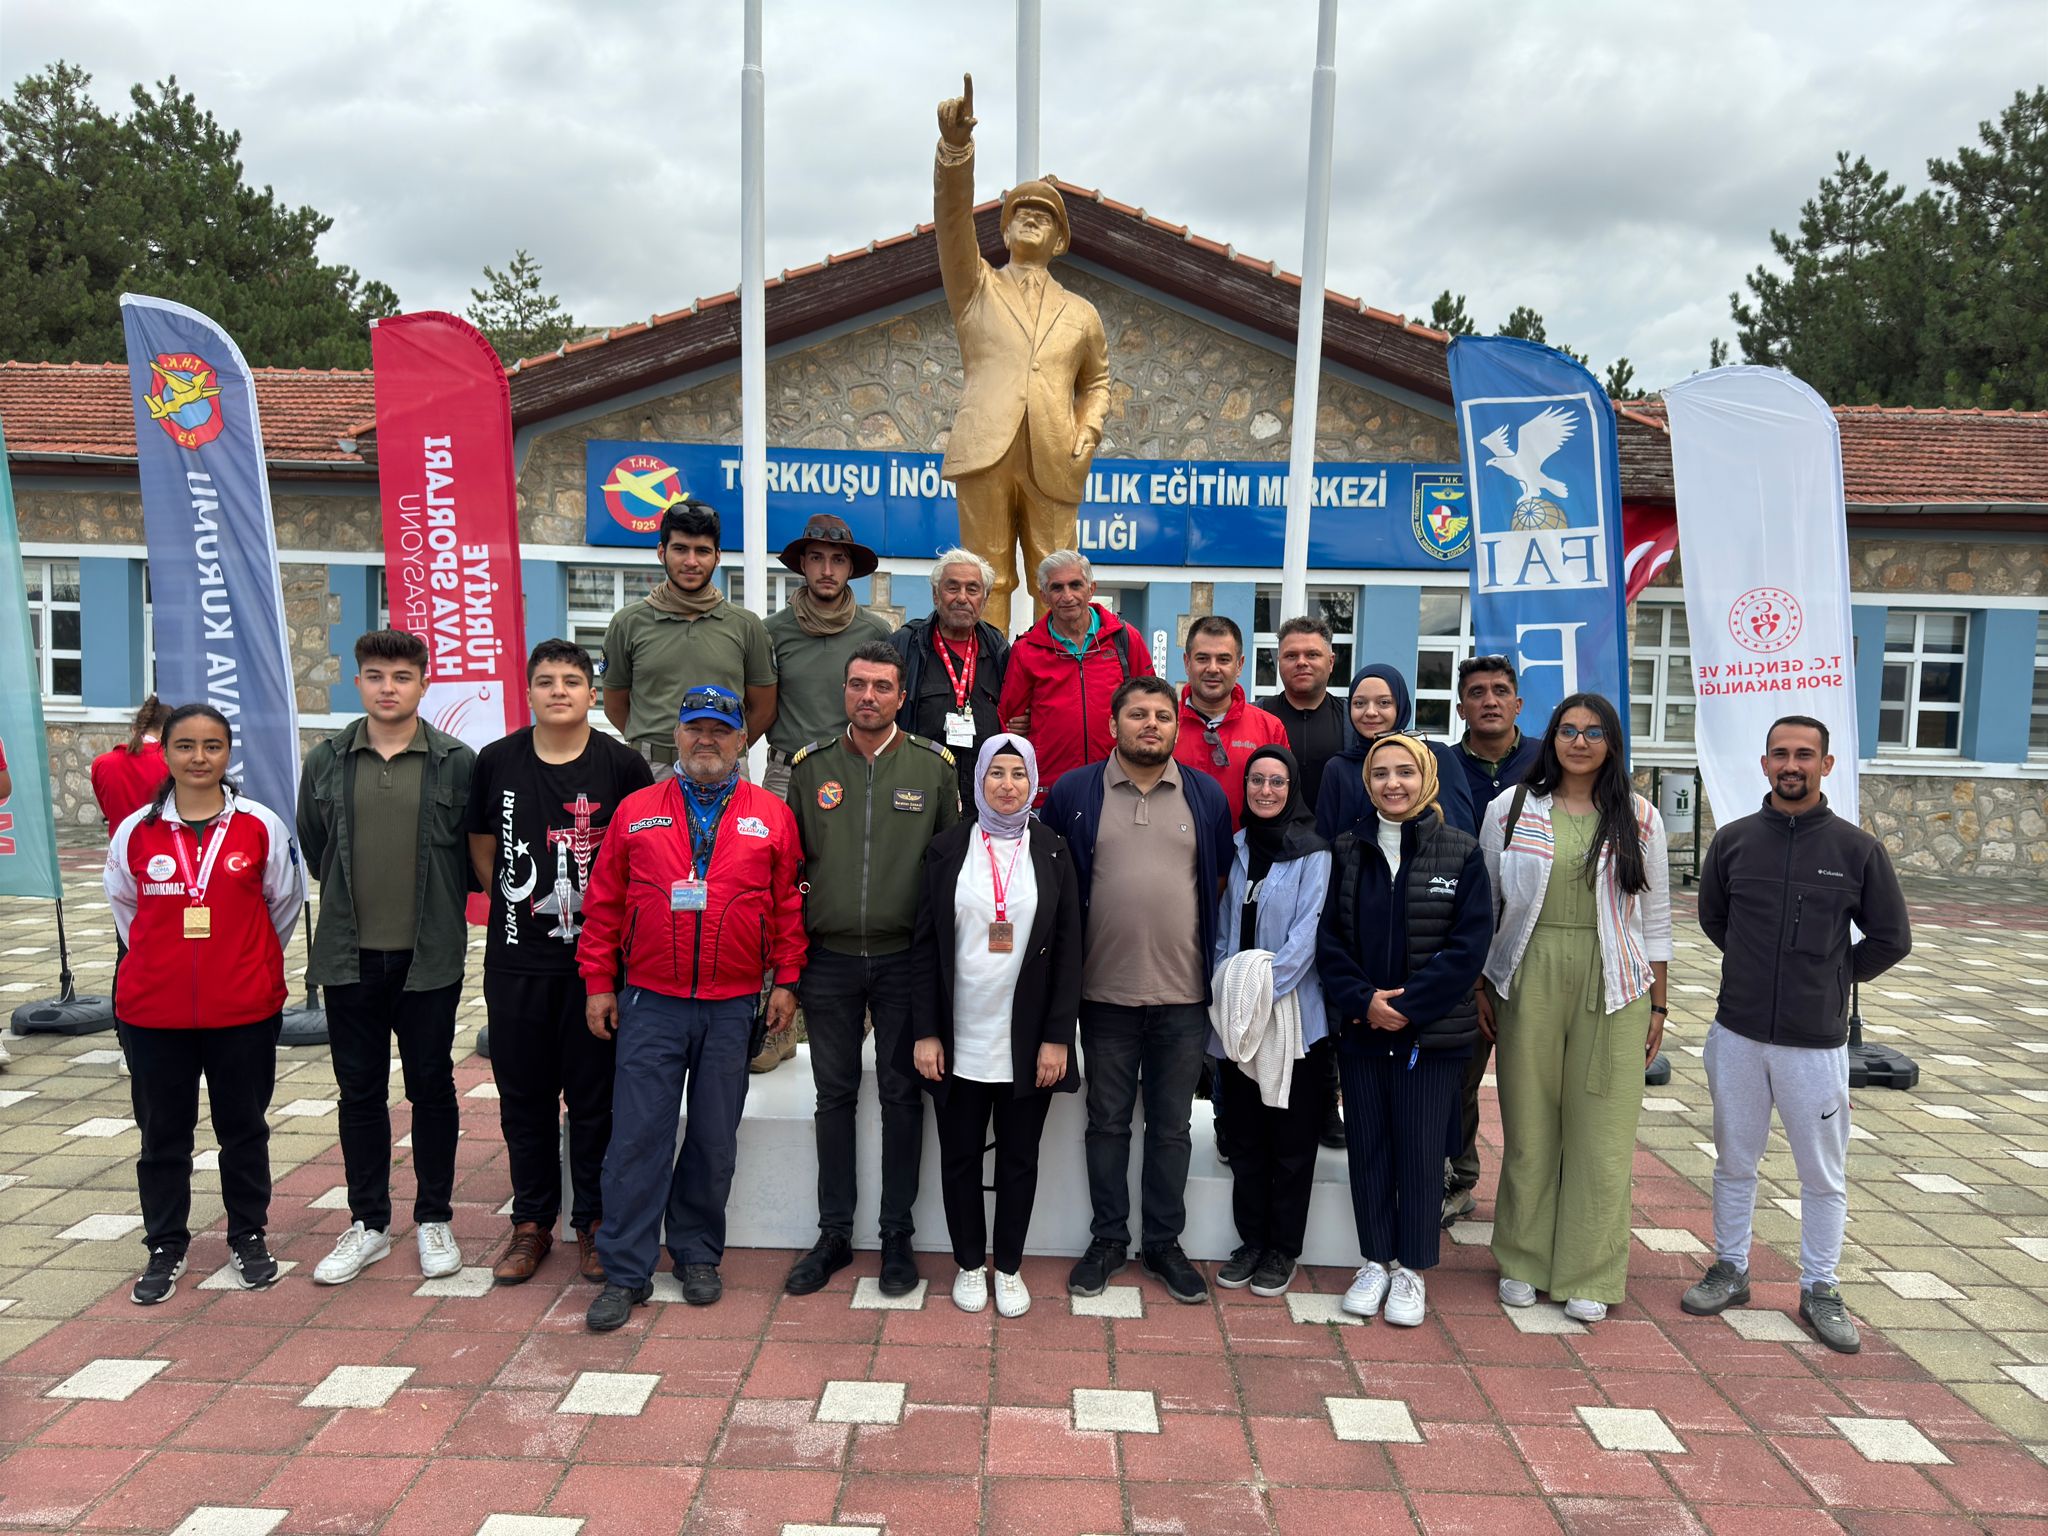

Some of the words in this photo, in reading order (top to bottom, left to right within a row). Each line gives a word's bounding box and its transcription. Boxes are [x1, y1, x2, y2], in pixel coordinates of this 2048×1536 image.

[629, 458, 660, 470] T.H.K.
[721, 459, 880, 503] TRKKUŞU
[890, 459, 957, 499] İNÖN
[1085, 472, 1142, 504] ILIK
[1150, 467, 1250, 506] EĞİTİM
[1439, 476, 1459, 484] THK
[631, 519, 657, 531] 1925
[1076, 513, 1137, 551] LIĞI
[502, 789, 516, 884] YILDIZLARI
[505, 900, 519, 945] TÜRK
